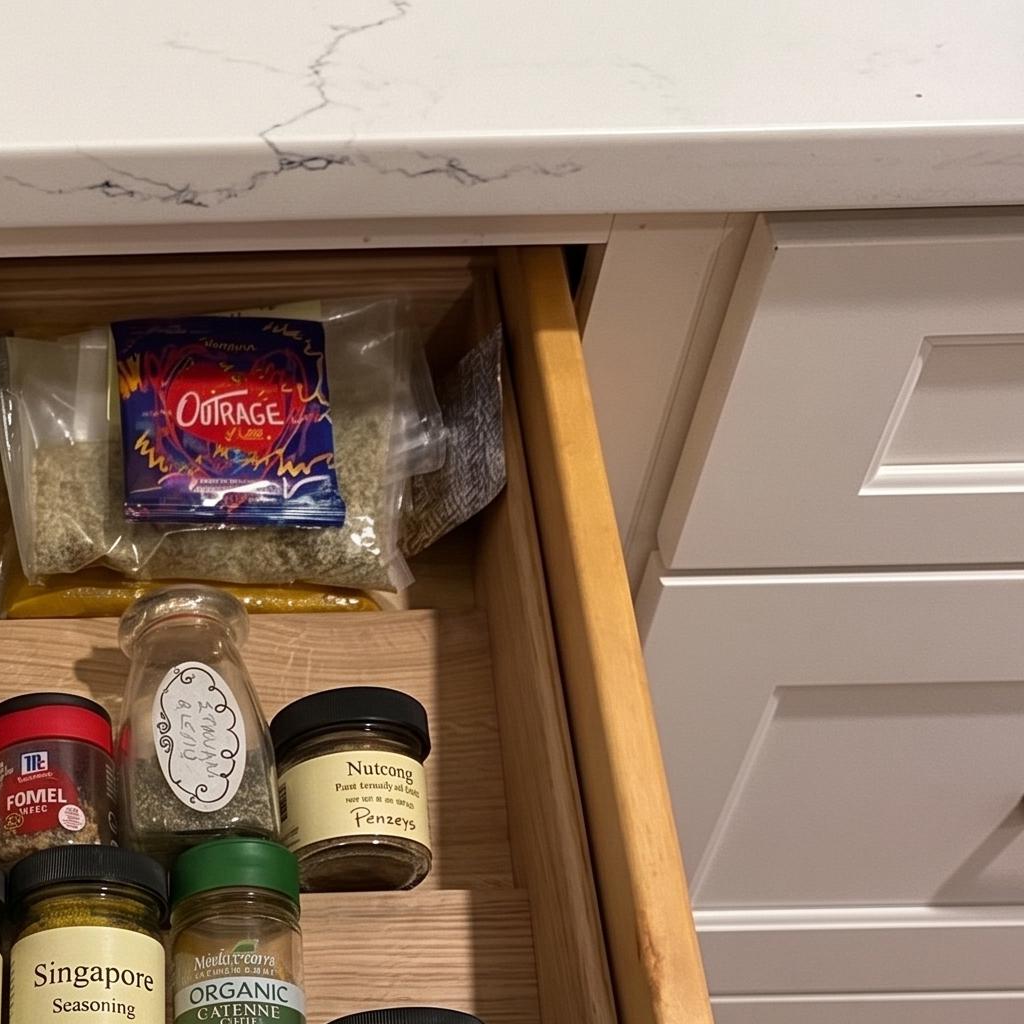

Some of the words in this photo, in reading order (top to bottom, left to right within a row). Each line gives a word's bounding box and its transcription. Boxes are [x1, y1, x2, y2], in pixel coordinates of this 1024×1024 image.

[350, 807, 416, 831] Penzeys
[34, 961, 154, 992] Singapore
[190, 982, 288, 1005] ORGANIC
[53, 998, 136, 1020] Seasoning
